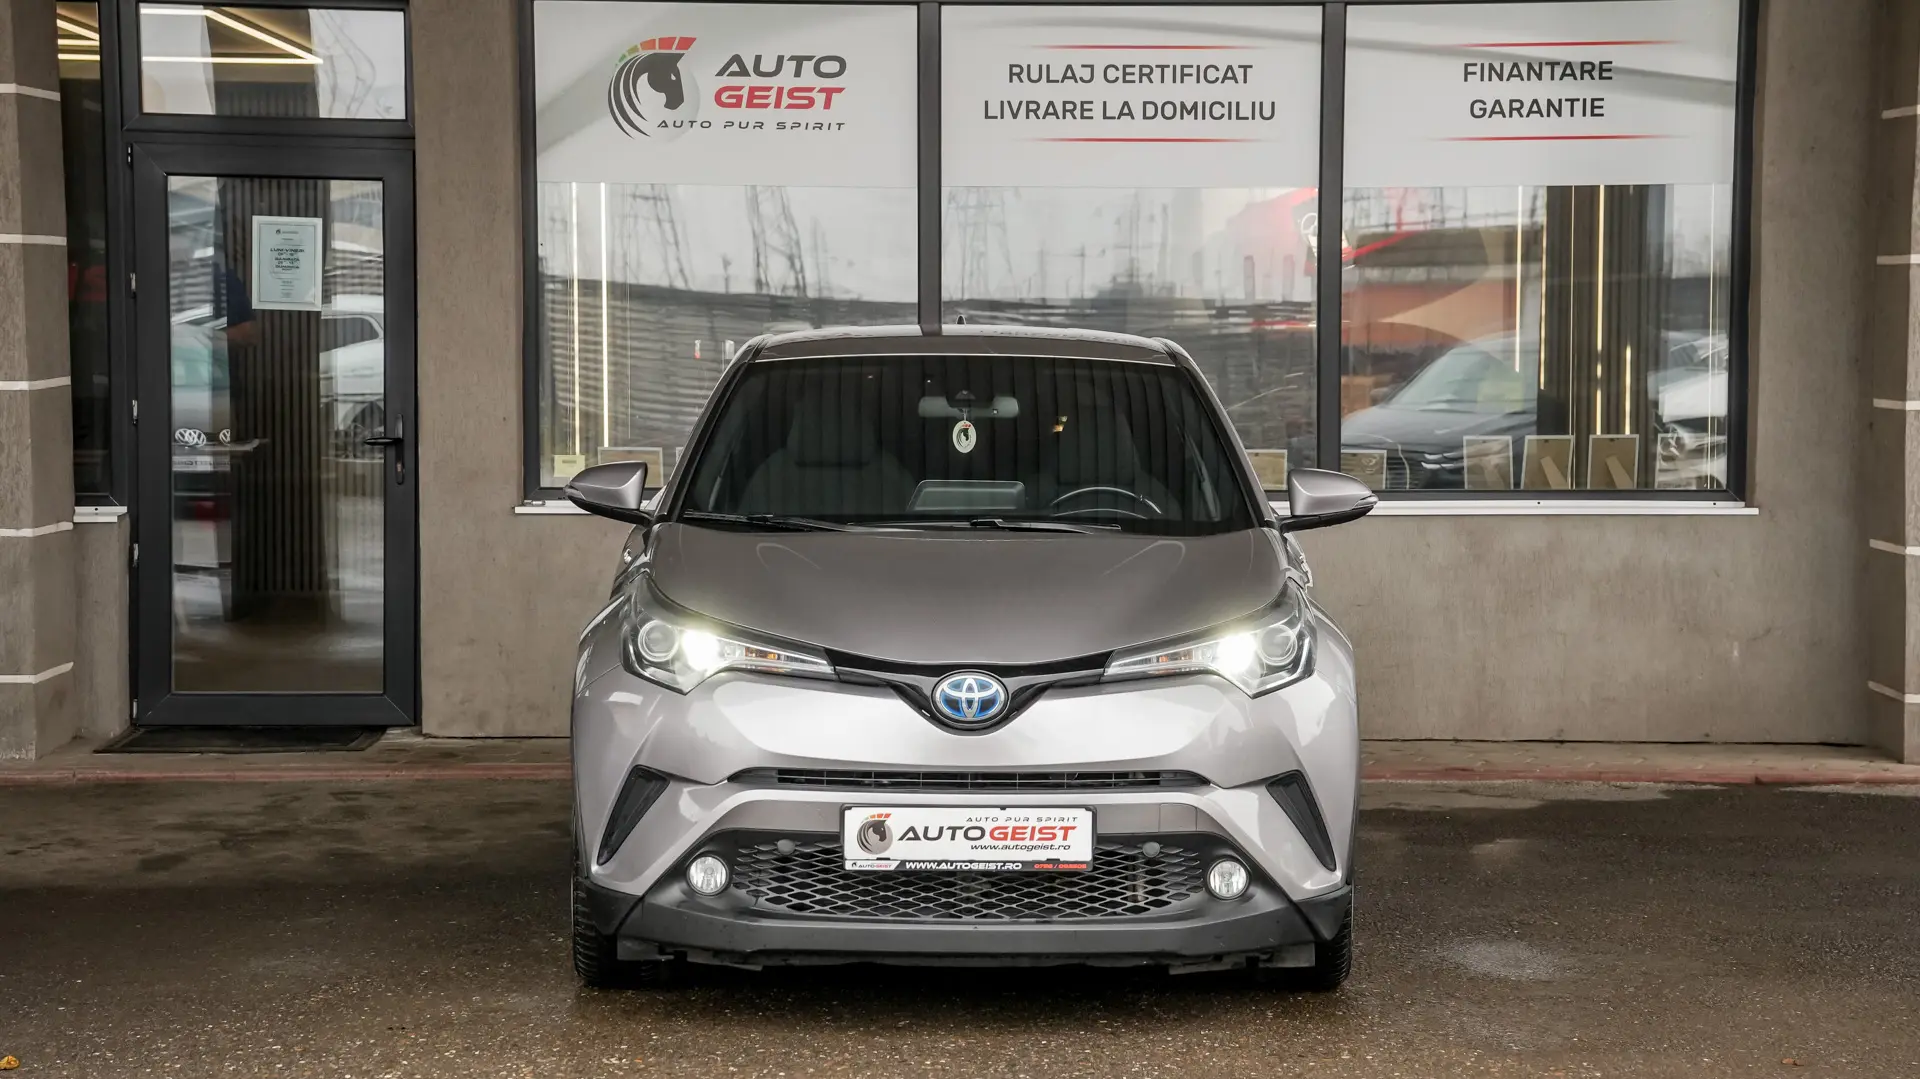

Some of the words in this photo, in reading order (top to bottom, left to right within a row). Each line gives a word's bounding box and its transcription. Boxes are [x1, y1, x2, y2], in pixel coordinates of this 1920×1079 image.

[715, 54, 846, 78] AUTO
[1009, 64, 1094, 83] RULAJ
[1104, 64, 1253, 84] CERTIFICAT
[1463, 61, 1613, 82] FINANTARE
[715, 86, 845, 109] GEIST
[985, 100, 1093, 119] LIVRARE
[1103, 101, 1135, 120] LA
[1143, 101, 1275, 120] DOMICILIU
[1470, 98, 1604, 118] GARANTIE
[657, 120, 711, 128] AUTO
[724, 121, 764, 129] PUR
[776, 122, 845, 130] SPIRIT
[971, 843, 1070, 852] www.autogeist.ro
[905, 861, 1022, 870] WWW.AUTOGEIST.RO
